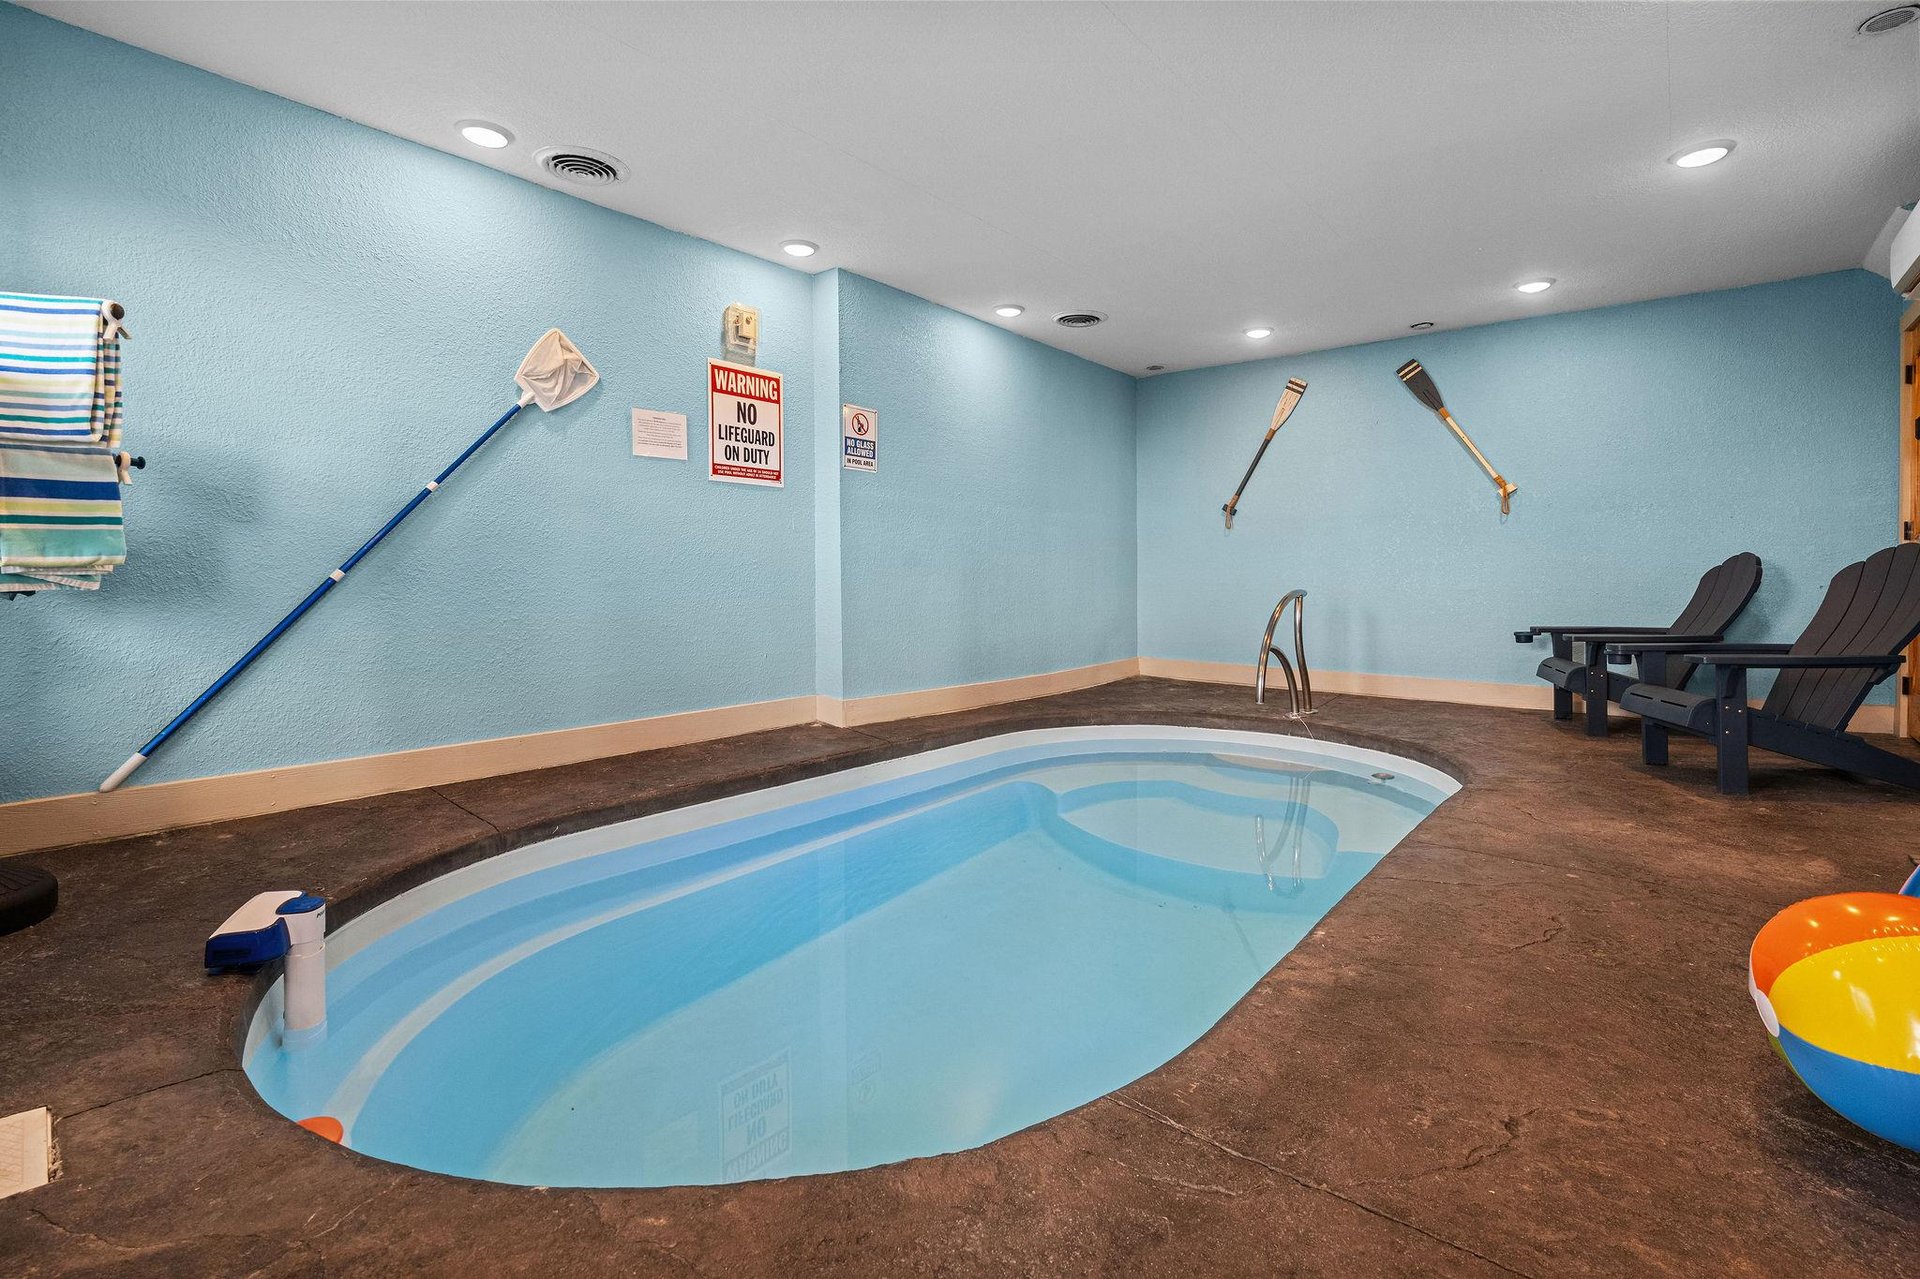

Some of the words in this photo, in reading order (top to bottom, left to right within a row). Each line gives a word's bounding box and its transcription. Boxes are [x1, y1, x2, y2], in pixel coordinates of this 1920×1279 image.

[714, 368, 778, 401] WARNING
[736, 401, 757, 425] NO
[718, 424, 775, 447] LIFEGUARD
[846, 438, 855, 447] NO
[856, 440, 874, 450] GLASS
[724, 444, 740, 462] ON
[744, 447, 770, 465] DUTY
[846, 446, 874, 458] ALLOWED
